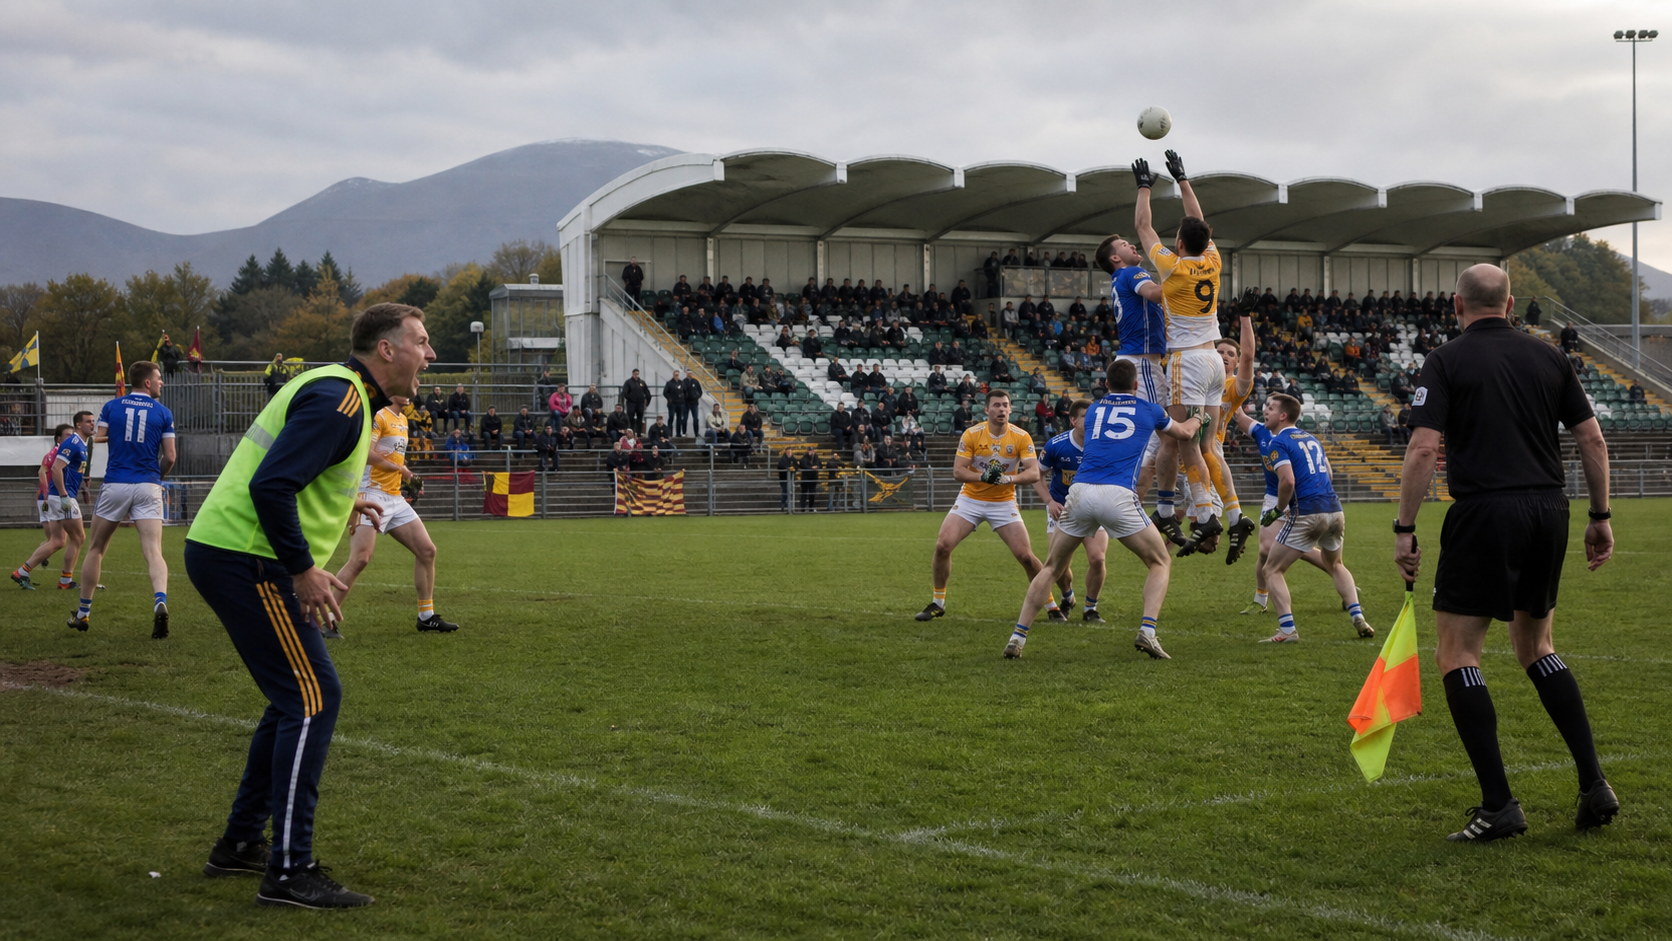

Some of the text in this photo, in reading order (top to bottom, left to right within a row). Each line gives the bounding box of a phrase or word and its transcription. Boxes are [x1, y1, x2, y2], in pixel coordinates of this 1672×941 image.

[1194, 279, 1215, 315] 9
[124, 407, 148, 443] 11
[1091, 406, 1136, 440] 15
[1298, 440, 1327, 475] 12
